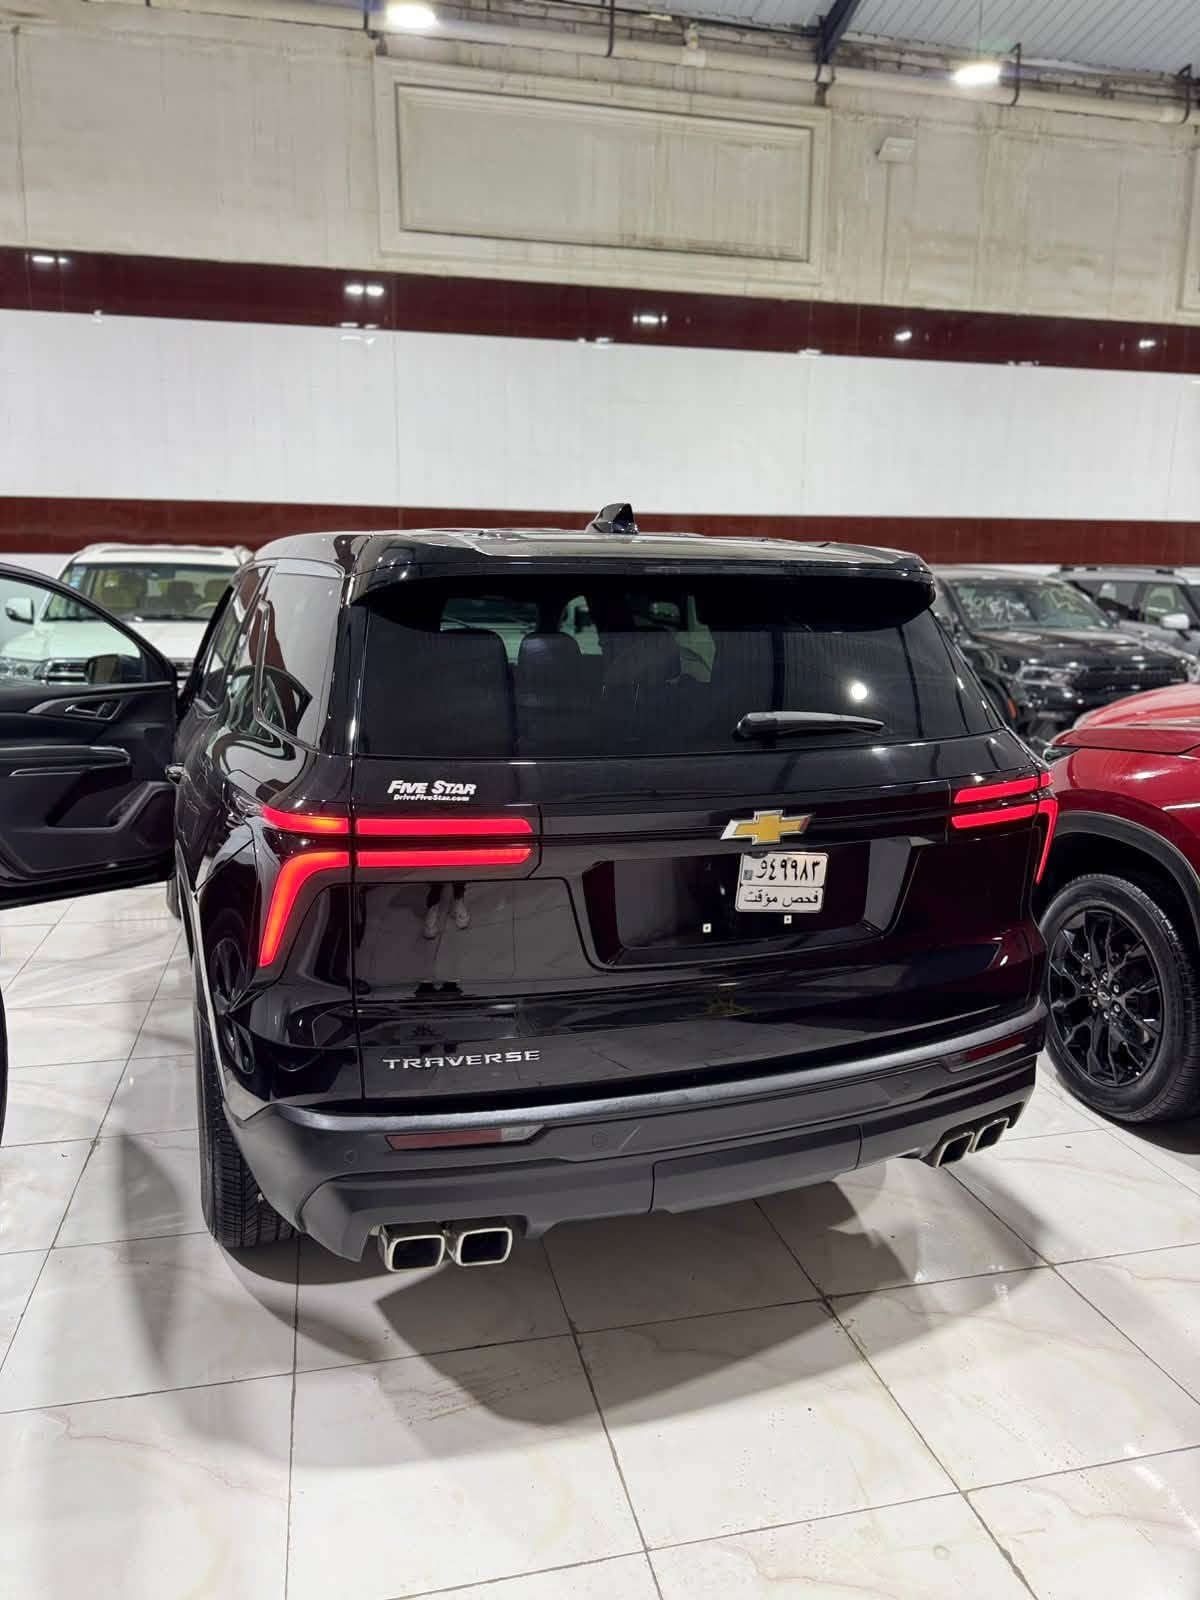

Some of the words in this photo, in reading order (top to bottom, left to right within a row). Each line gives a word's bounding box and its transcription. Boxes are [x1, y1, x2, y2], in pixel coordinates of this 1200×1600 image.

[431, 780, 477, 795] STAR
[782, 890, 819, 908] فحص
[382, 1050, 541, 1070] TRAVERSE
